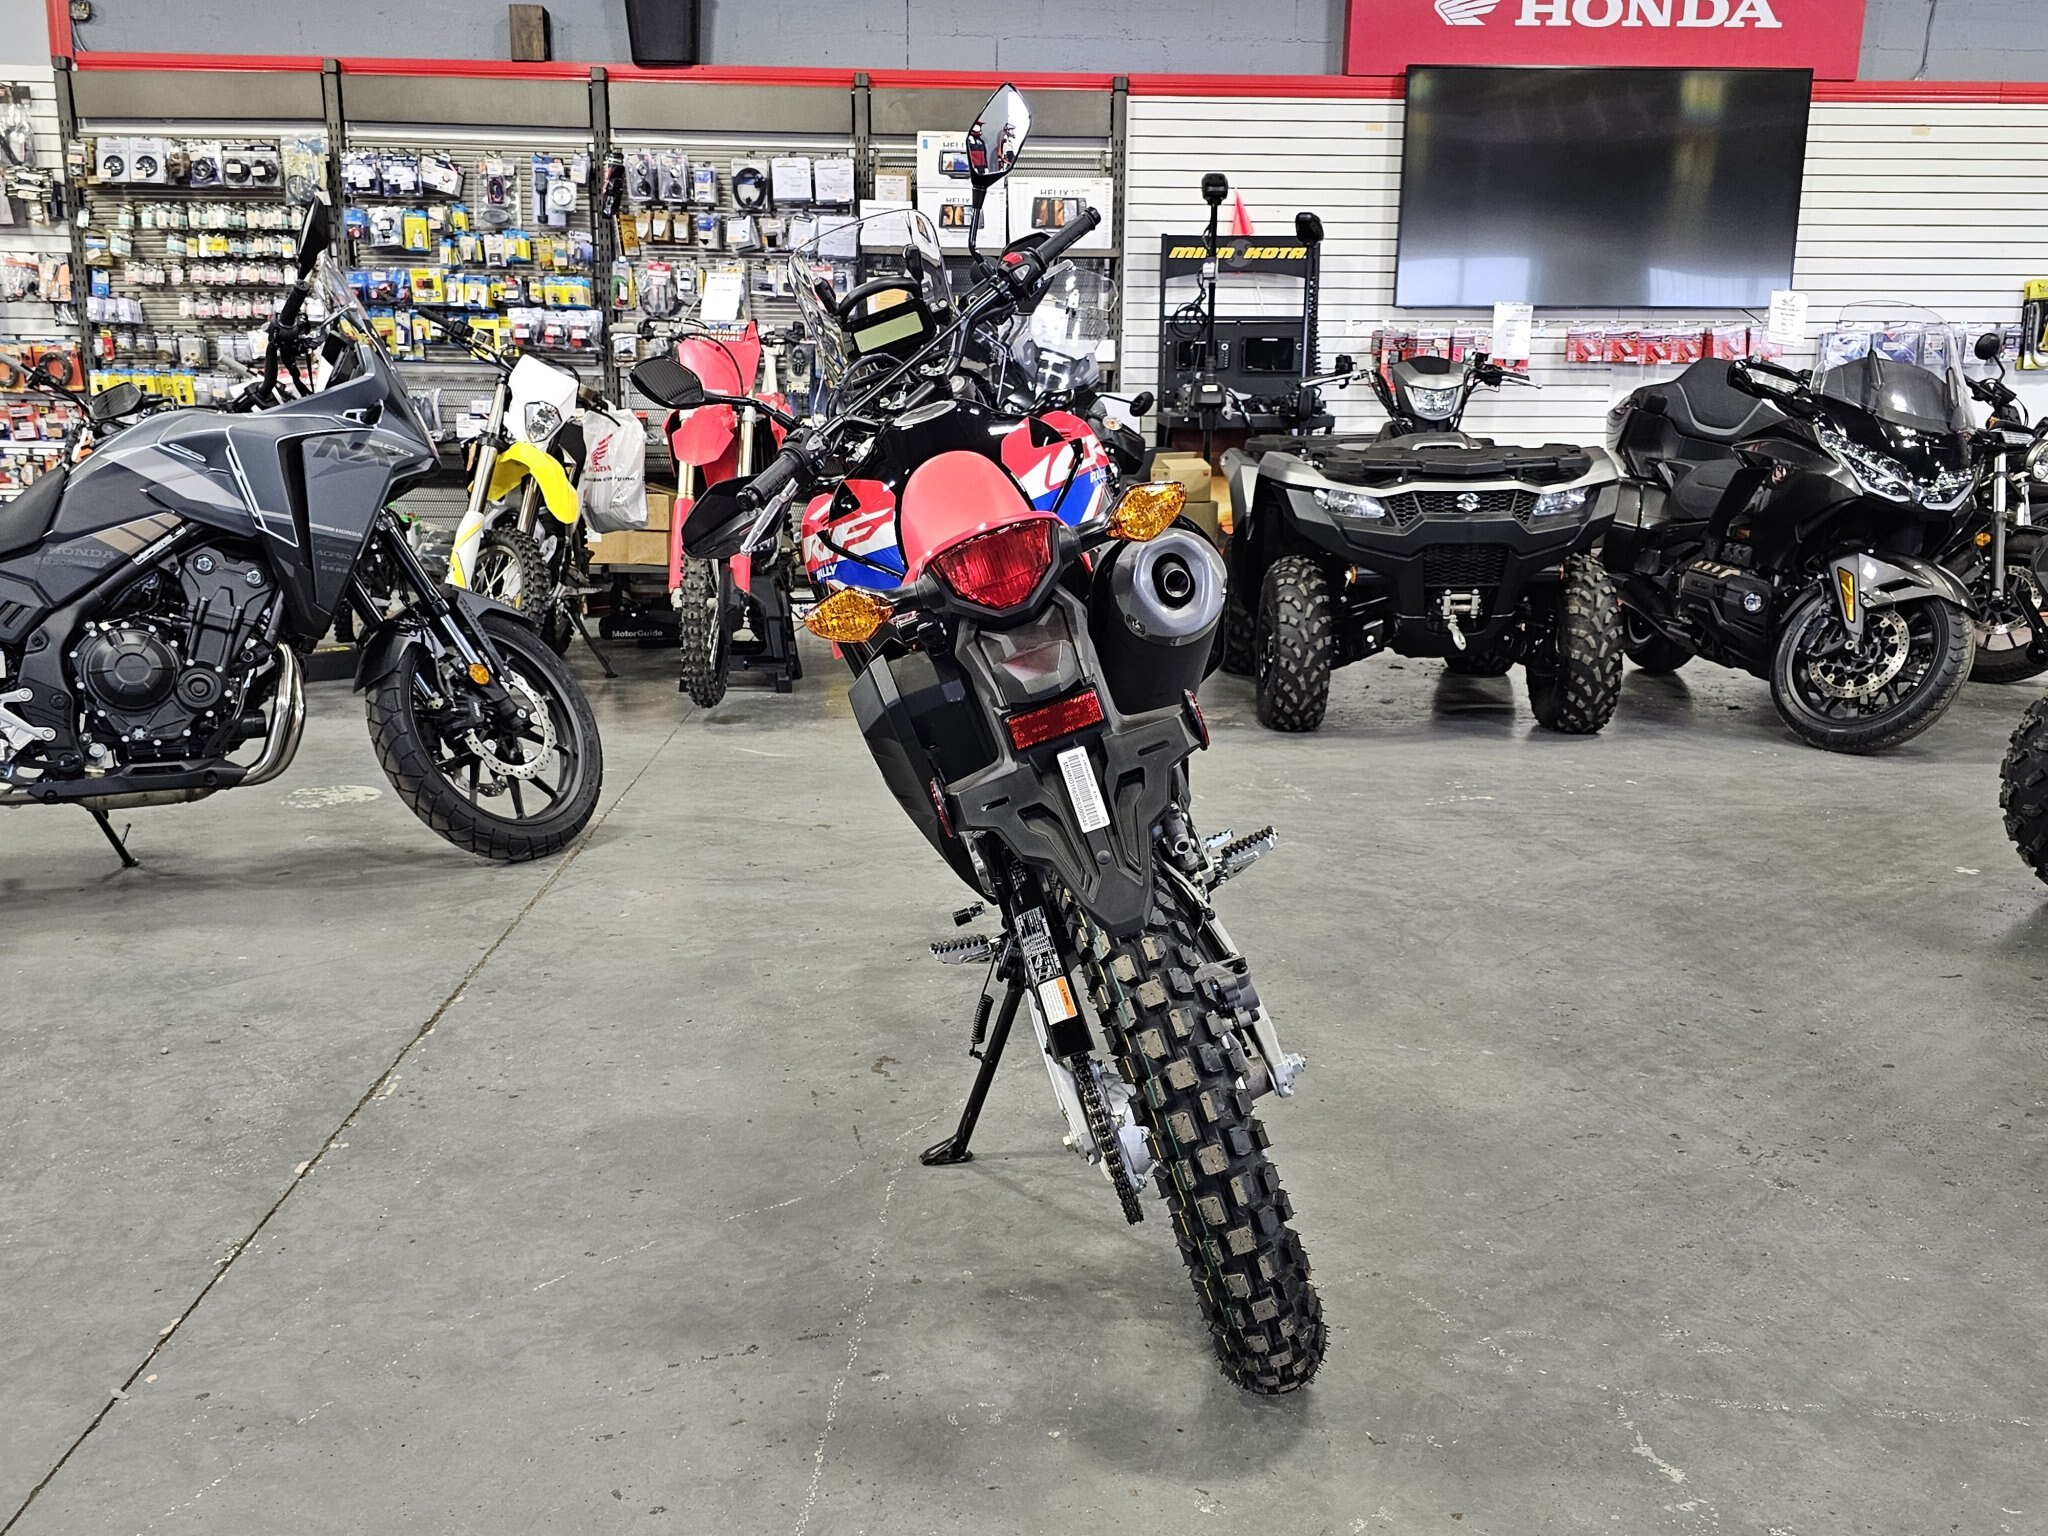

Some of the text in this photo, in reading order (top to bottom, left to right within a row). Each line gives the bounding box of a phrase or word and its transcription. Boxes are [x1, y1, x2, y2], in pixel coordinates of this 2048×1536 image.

[1514, 0, 1783, 28] HONDA
[942, 141, 964, 149] HELI
[335, 527, 363, 538] HONDA
[47, 546, 116, 560] HONDA
[611, 629, 664, 638] MotorGuide
